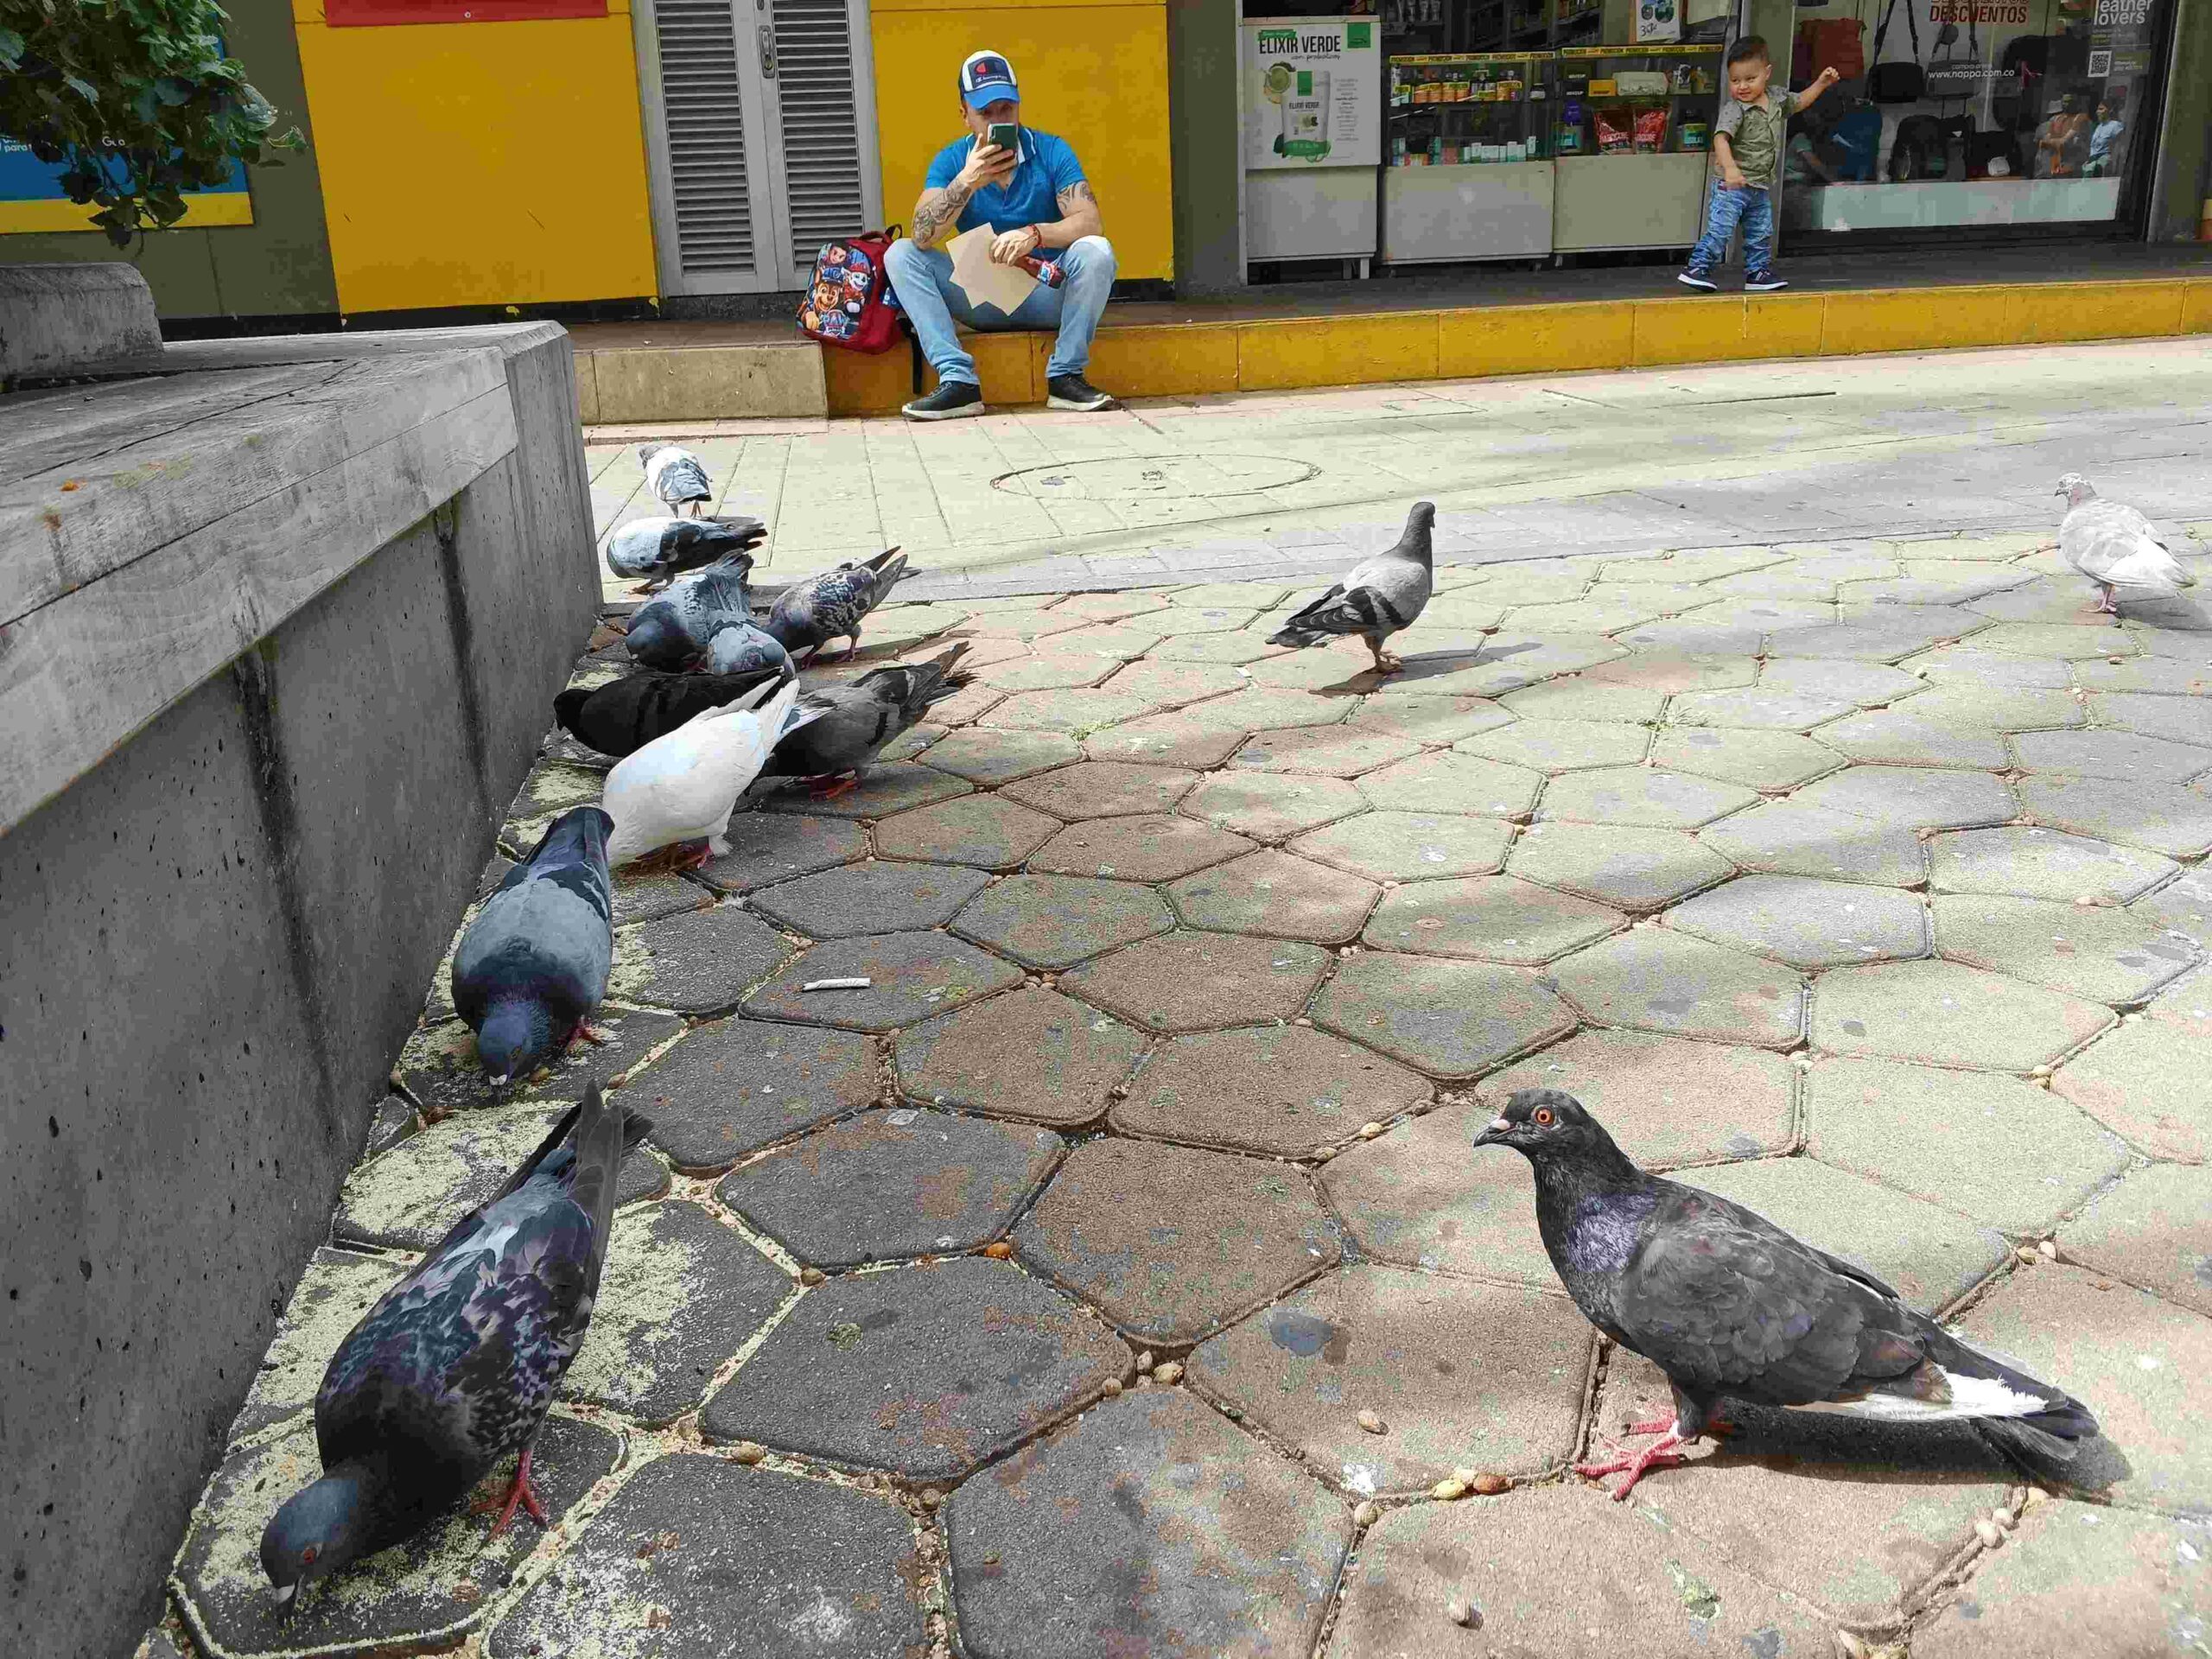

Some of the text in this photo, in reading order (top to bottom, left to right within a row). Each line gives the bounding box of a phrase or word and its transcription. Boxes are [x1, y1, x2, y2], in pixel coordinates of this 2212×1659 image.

[1929, 6, 2028, 22] DESCUENTOS
[2094, 6, 2145, 25] lovers
[1259, 35, 1298, 54] ELIXIR
[1302, 35, 1341, 53] VERDE
[1929, 69, 2015, 79] www.nappa.com.co
